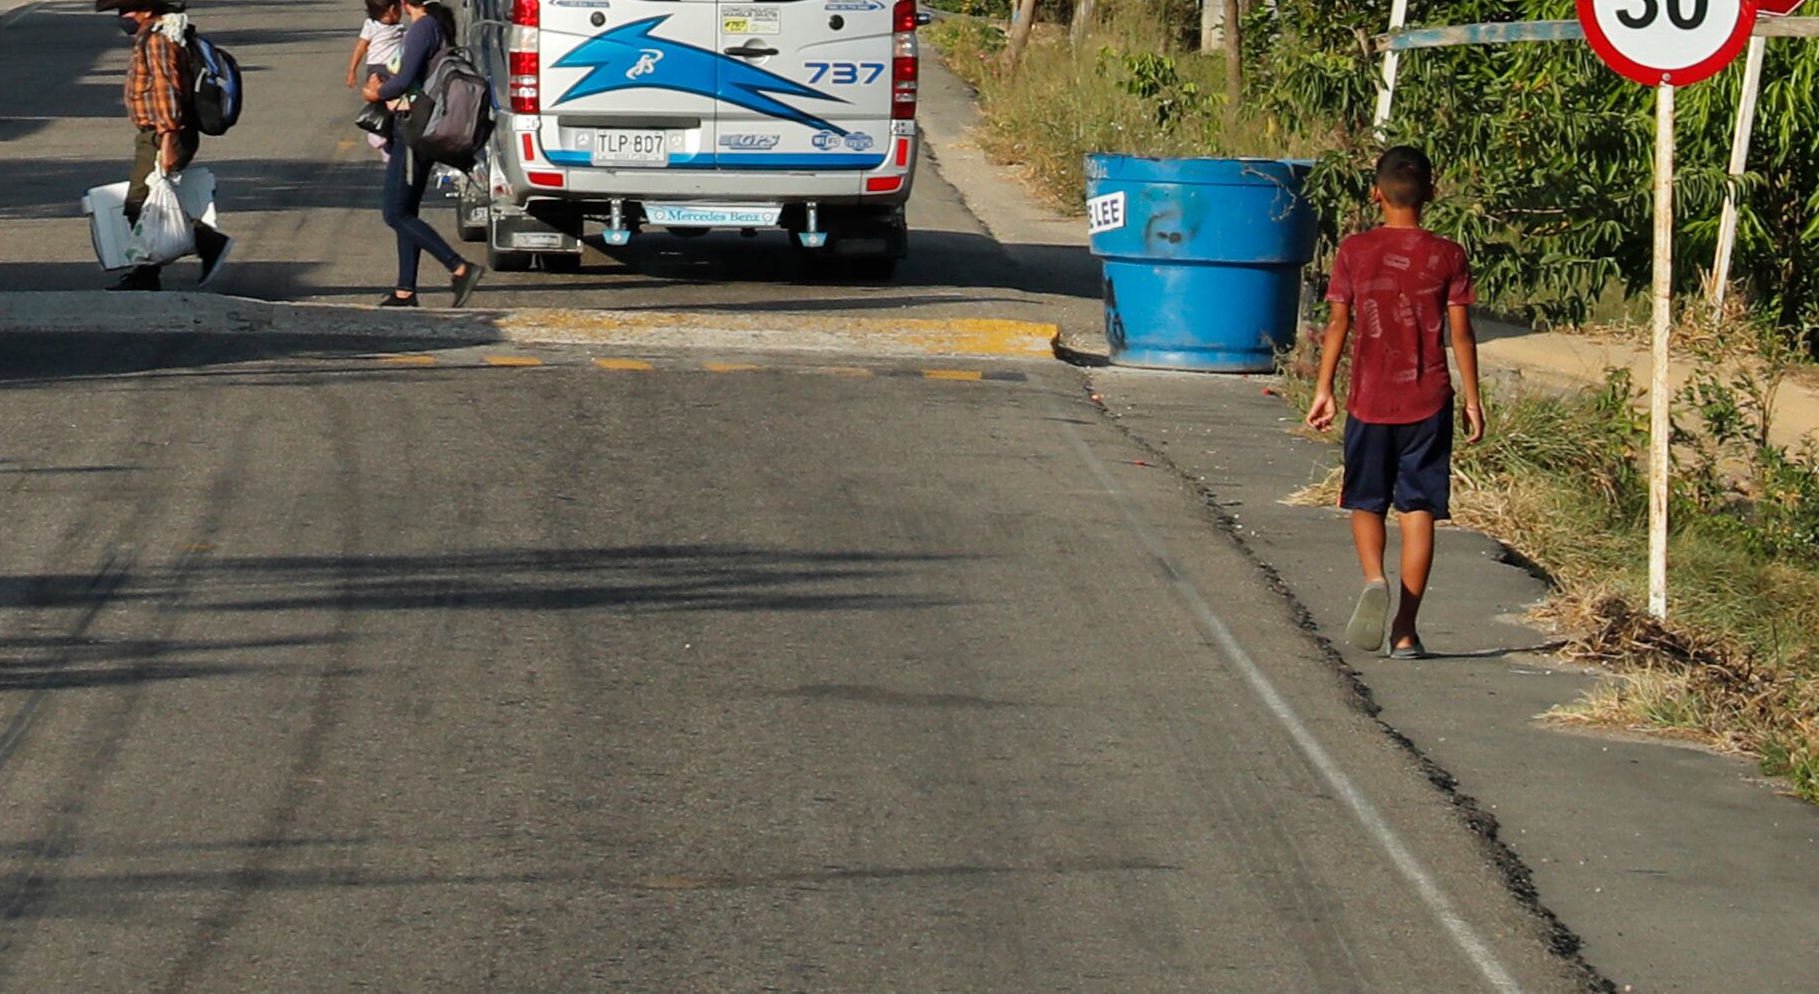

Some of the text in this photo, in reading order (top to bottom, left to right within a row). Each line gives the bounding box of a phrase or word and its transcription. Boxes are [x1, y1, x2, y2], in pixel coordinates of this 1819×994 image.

[804, 62, 886, 85] 737
[667, 209, 760, 223] Mercedes Benz
